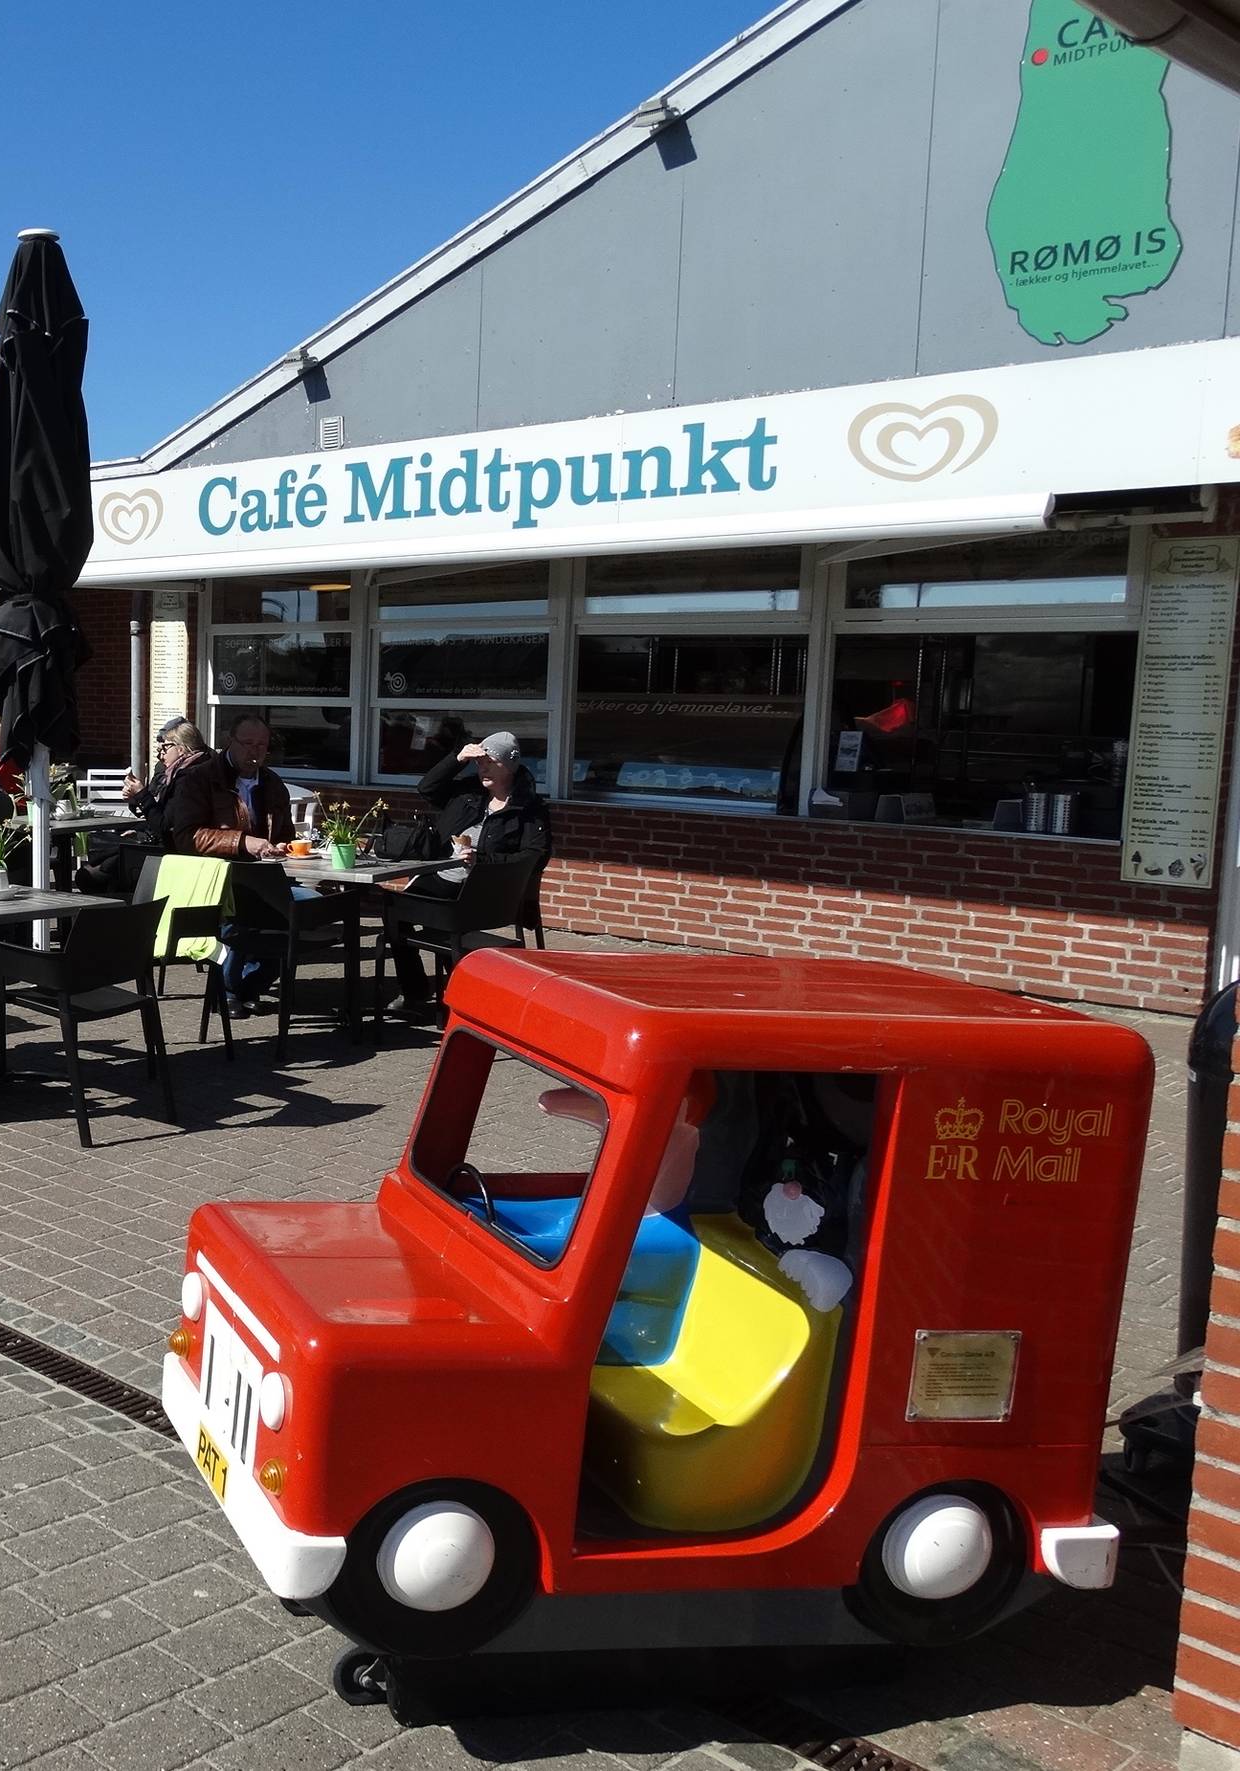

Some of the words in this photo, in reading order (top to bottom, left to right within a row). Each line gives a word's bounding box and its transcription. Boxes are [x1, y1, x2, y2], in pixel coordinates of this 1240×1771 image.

[1053, 38, 1135, 66] MIDTPUN
[1009, 234, 1122, 276] RØMØ
[1133, 227, 1167, 257] IS
[1015, 274, 1053, 288] lækker
[1055, 272, 1070, 285] og
[197, 464, 328, 536] Café
[343, 417, 778, 529] Midtpunkt
[625, 702, 649, 716] og
[998, 1098, 1114, 1145] Royal
[992, 1146, 1082, 1183] Mail
[196, 1429, 220, 1483] PAT
[221, 1465, 228, 1499] 1
